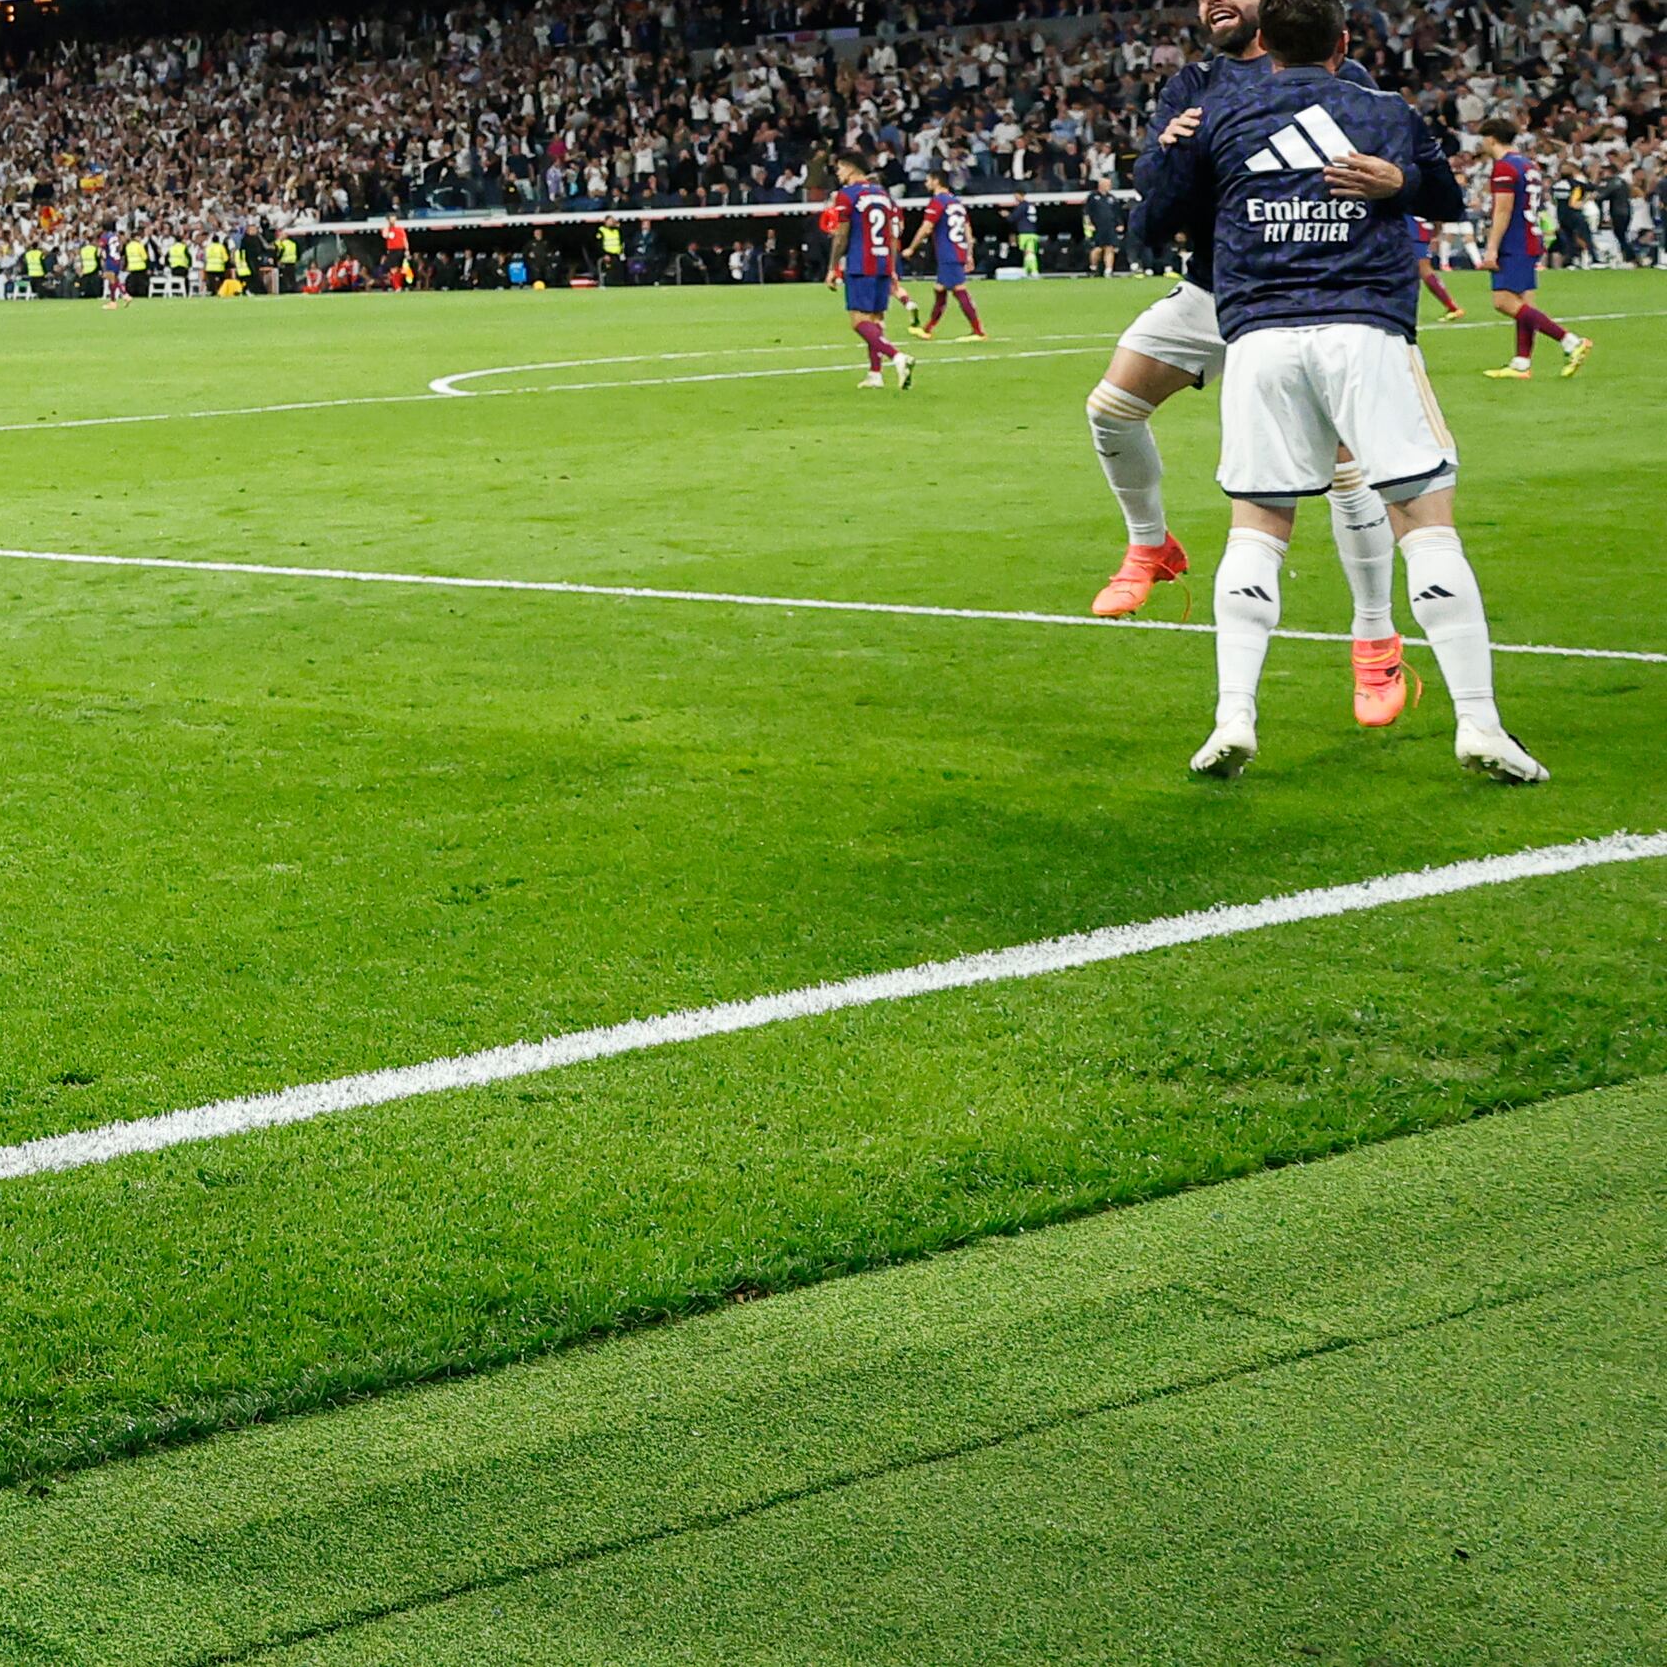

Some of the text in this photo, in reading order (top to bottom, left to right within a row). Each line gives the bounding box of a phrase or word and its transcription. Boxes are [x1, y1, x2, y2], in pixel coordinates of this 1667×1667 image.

[1246, 196, 1368, 222] Emirates
[869, 208, 885, 245] 2
[1264, 222, 1350, 243] FLY BETTER
